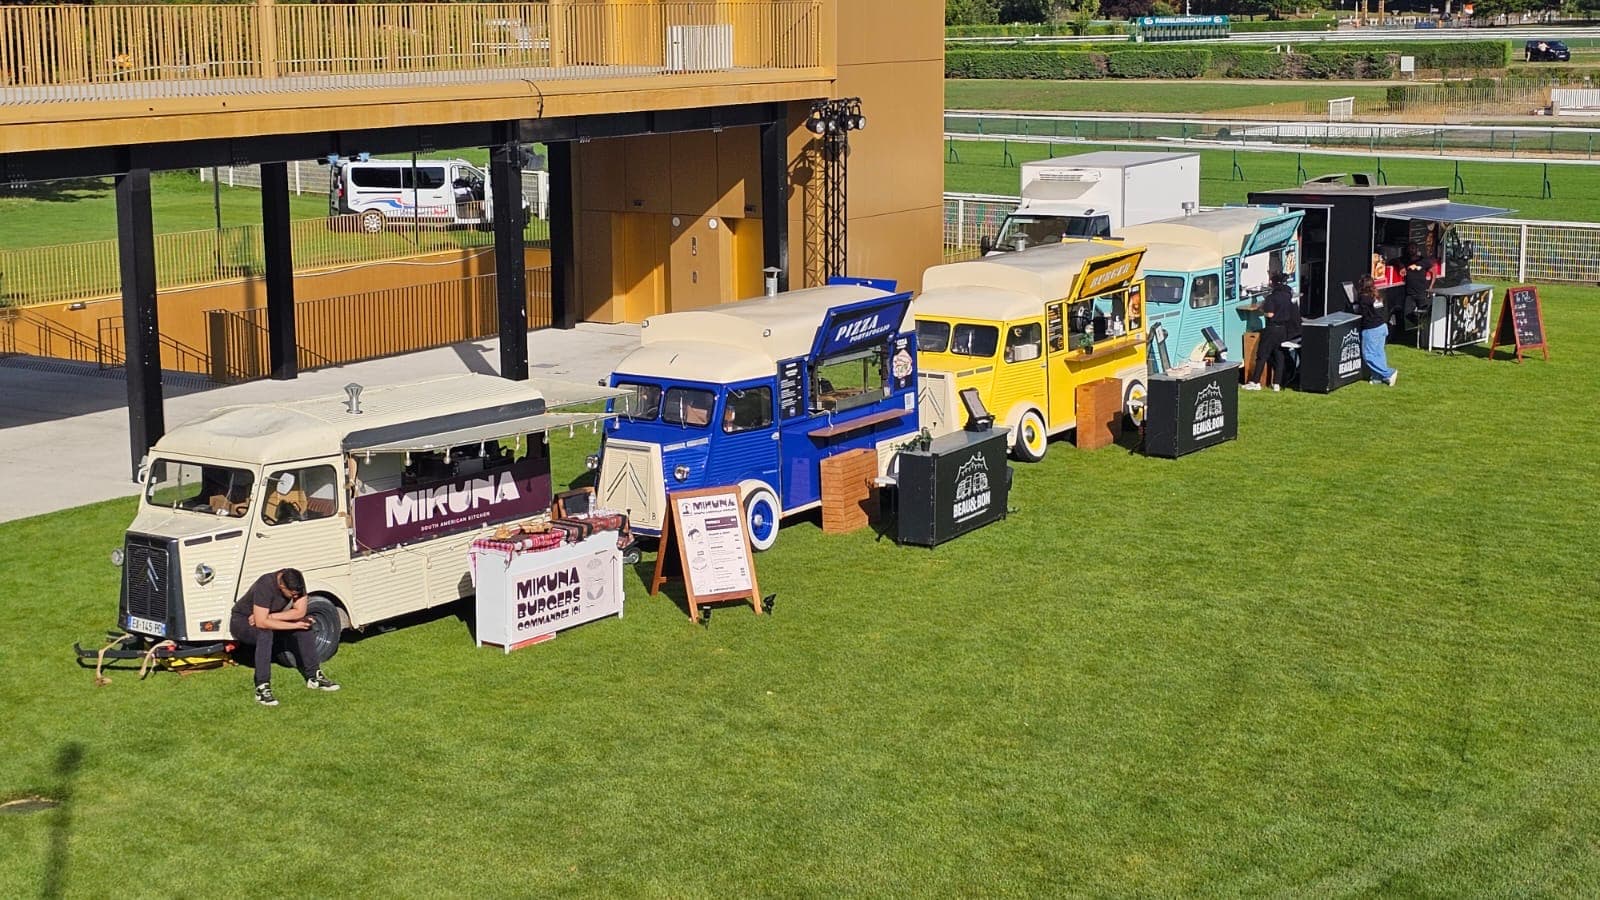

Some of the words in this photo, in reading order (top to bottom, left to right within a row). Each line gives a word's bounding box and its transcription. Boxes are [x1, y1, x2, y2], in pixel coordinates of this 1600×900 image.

[835, 315, 879, 342] PIZZA
[385, 471, 520, 528] MIKUNA
[421, 523, 439, 531] SOUTH
[440, 517, 467, 527] AMERICAN
[468, 511, 490, 521] KITCHEN
[517, 567, 580, 600] MIKUNA
[517, 587, 580, 619] BURGERS
[517, 608, 569, 631] COMMANDEZ
[572, 605, 580, 617] ICI
